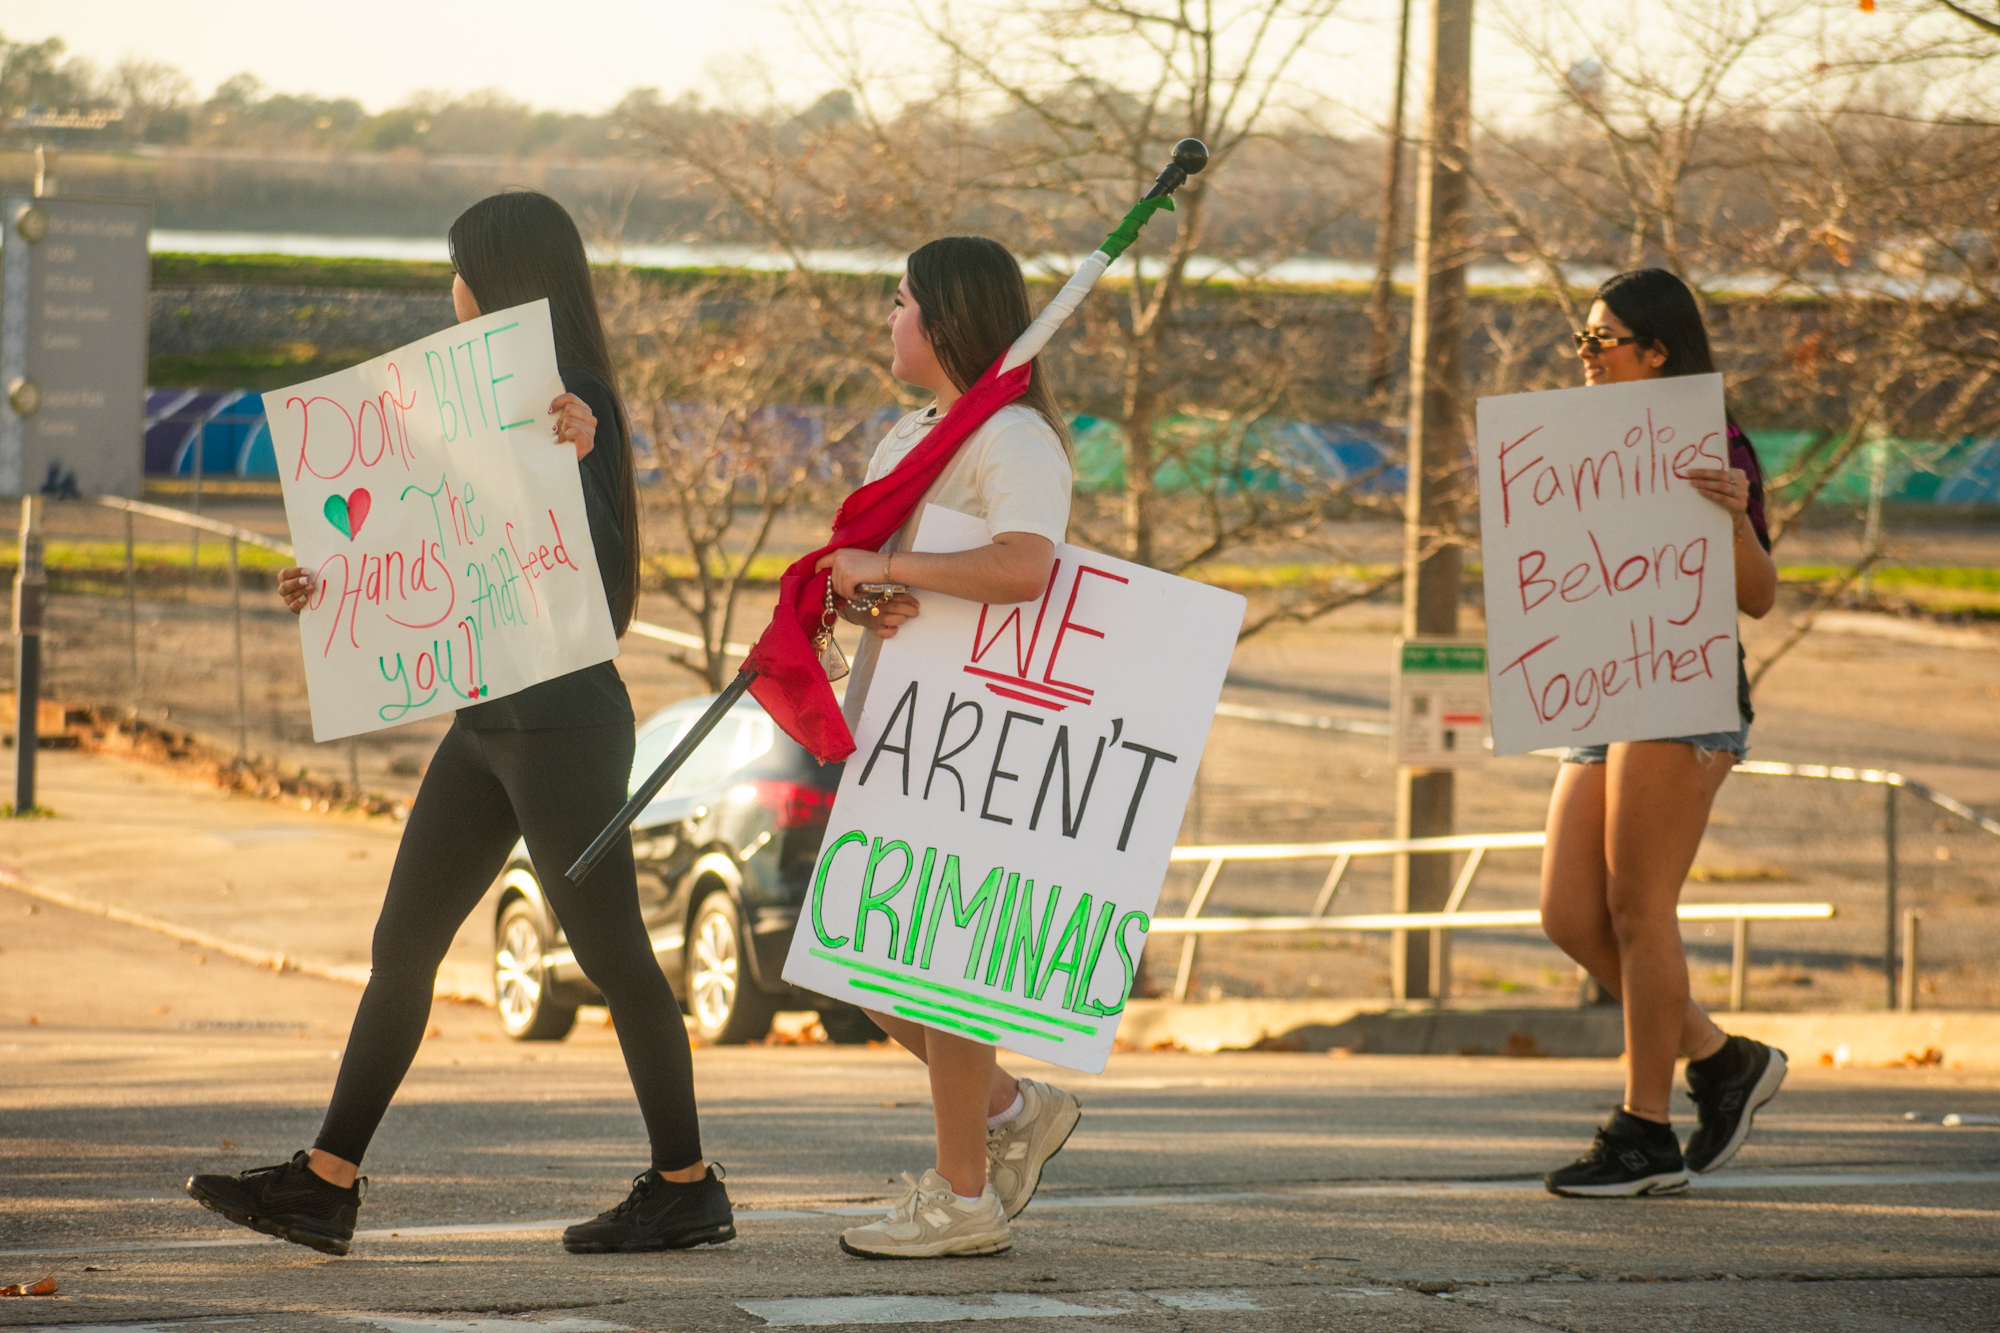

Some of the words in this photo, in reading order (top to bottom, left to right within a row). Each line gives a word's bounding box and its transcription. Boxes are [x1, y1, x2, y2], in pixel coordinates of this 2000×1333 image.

[425, 322, 535, 443] BITE
[401, 473, 485, 560] The
[1498, 407, 1724, 528] Families
[309, 539, 455, 657] Hands
[506, 509, 579, 619] feed
[970, 558, 1129, 697] WE
[1518, 530, 1707, 625] Belong
[1498, 616, 1730, 732] Together
[858, 680, 1178, 852] AREN'T
[811, 829, 1151, 1018] CRIMINALS
[922, 1208, 952, 1228] N
[1619, 1150, 1649, 1171] N
